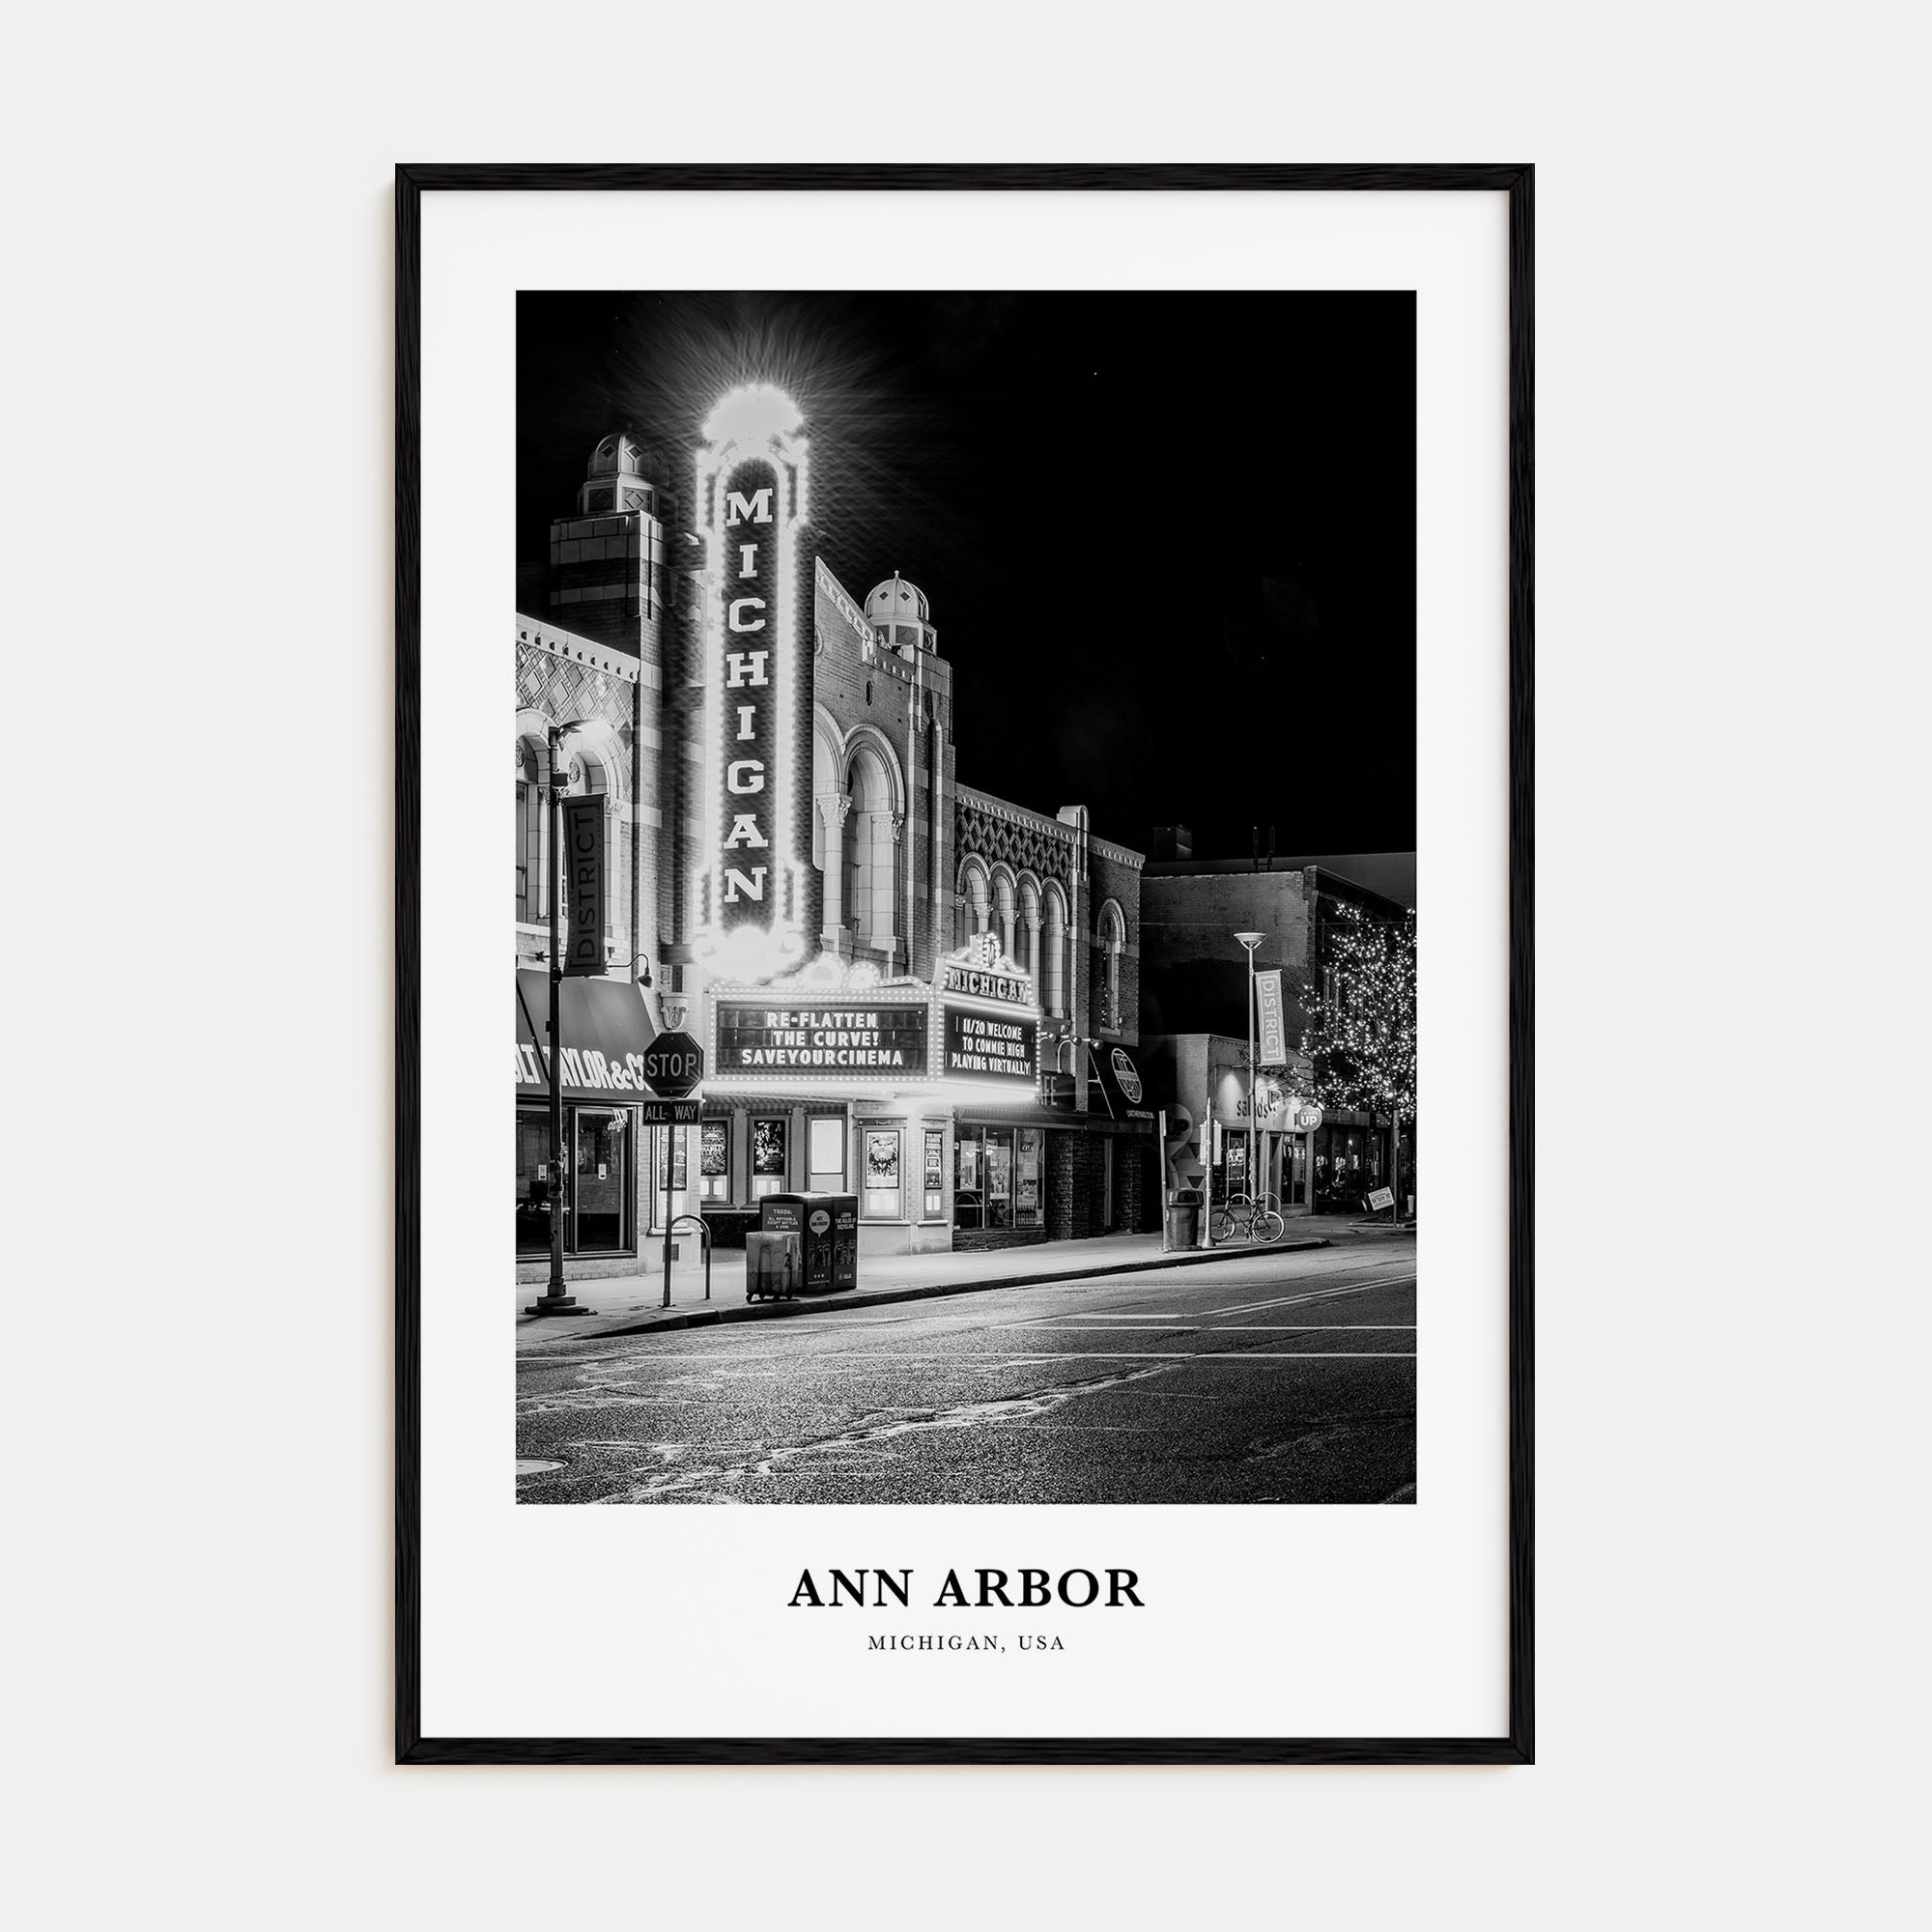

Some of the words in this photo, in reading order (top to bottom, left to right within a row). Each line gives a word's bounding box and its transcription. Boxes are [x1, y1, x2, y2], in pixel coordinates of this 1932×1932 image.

[724, 488, 773, 902] MICHIGAN
[576, 812, 596, 959] DISTRICT
[946, 967, 1028, 1003] MICHIGAN
[767, 1012, 877, 1028] RE-FLATTEN
[1263, 980, 1280, 1057] DISTRICT
[773, 1031, 806, 1045] THE
[813, 1031, 879, 1046] CURVE!
[986, 1021, 1022, 1040] WELCOME
[962, 1037, 974, 1051] TO
[646, 1053, 697, 1078] STOP
[741, 1049, 903, 1065] SAVEYOURCINEMA
[952, 1052, 987, 1070] PLAYING
[674, 1105, 697, 1121] WAY
[1300, 1115, 1319, 1126] UP
[787, 1568, 914, 1607] ANN
[933, 1568, 1146, 1607] ARBOR
[867, 1634, 1007, 1653] MICHIGAN,
[1019, 1634, 1065, 1651] USA
